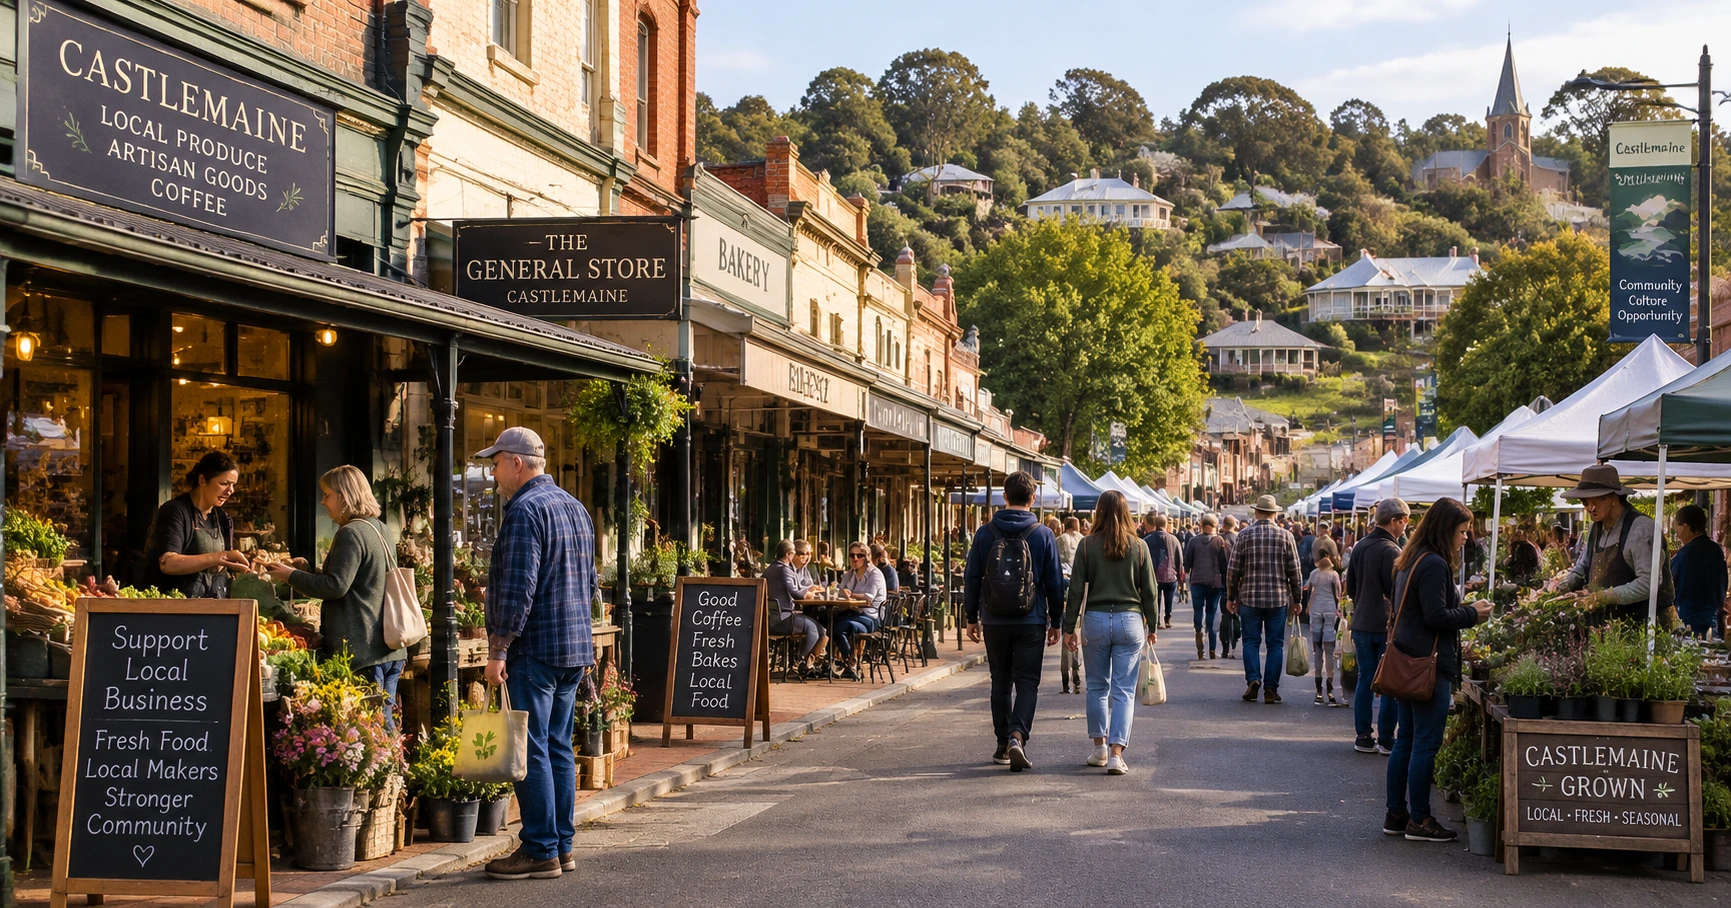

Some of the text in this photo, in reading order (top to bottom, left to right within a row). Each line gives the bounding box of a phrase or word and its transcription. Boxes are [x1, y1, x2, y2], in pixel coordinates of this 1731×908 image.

[59, 38, 307, 153] CASTLEMAINE
[101, 105, 268, 175] LOCAL PRODUCE
[107, 138, 268, 201] ARTISAN GOODS
[151, 178, 228, 217] COFFEE
[545, 234, 588, 251] THE
[466, 257, 666, 281] GENERAL STORE
[718, 236, 770, 293] BAKERY
[507, 289, 628, 304] CASTLEMAINE
[1619, 278, 1683, 294] Community
[1617, 309, 1683, 325] Opportunity
[698, 590, 738, 607] Good
[692, 609, 742, 631] Coffee
[111, 624, 209, 658] Support
[692, 631, 735, 649] Fresh
[125, 656, 188, 681] Local
[691, 651, 738, 669] Bakes
[689, 672, 732, 690] Local
[103, 686, 207, 712] Business
[691, 691, 729, 709] Food
[95, 729, 150, 751] Fresh
[85, 757, 218, 781] Local Makers
[1525, 745, 1680, 774] CASTLEMAINE
[1561, 775, 1646, 800] GROWN
[104, 786, 194, 814] Stronger
[87, 813, 207, 843] Community
[1527, 806, 1682, 827] LOCAL FRESH SEASONAL
